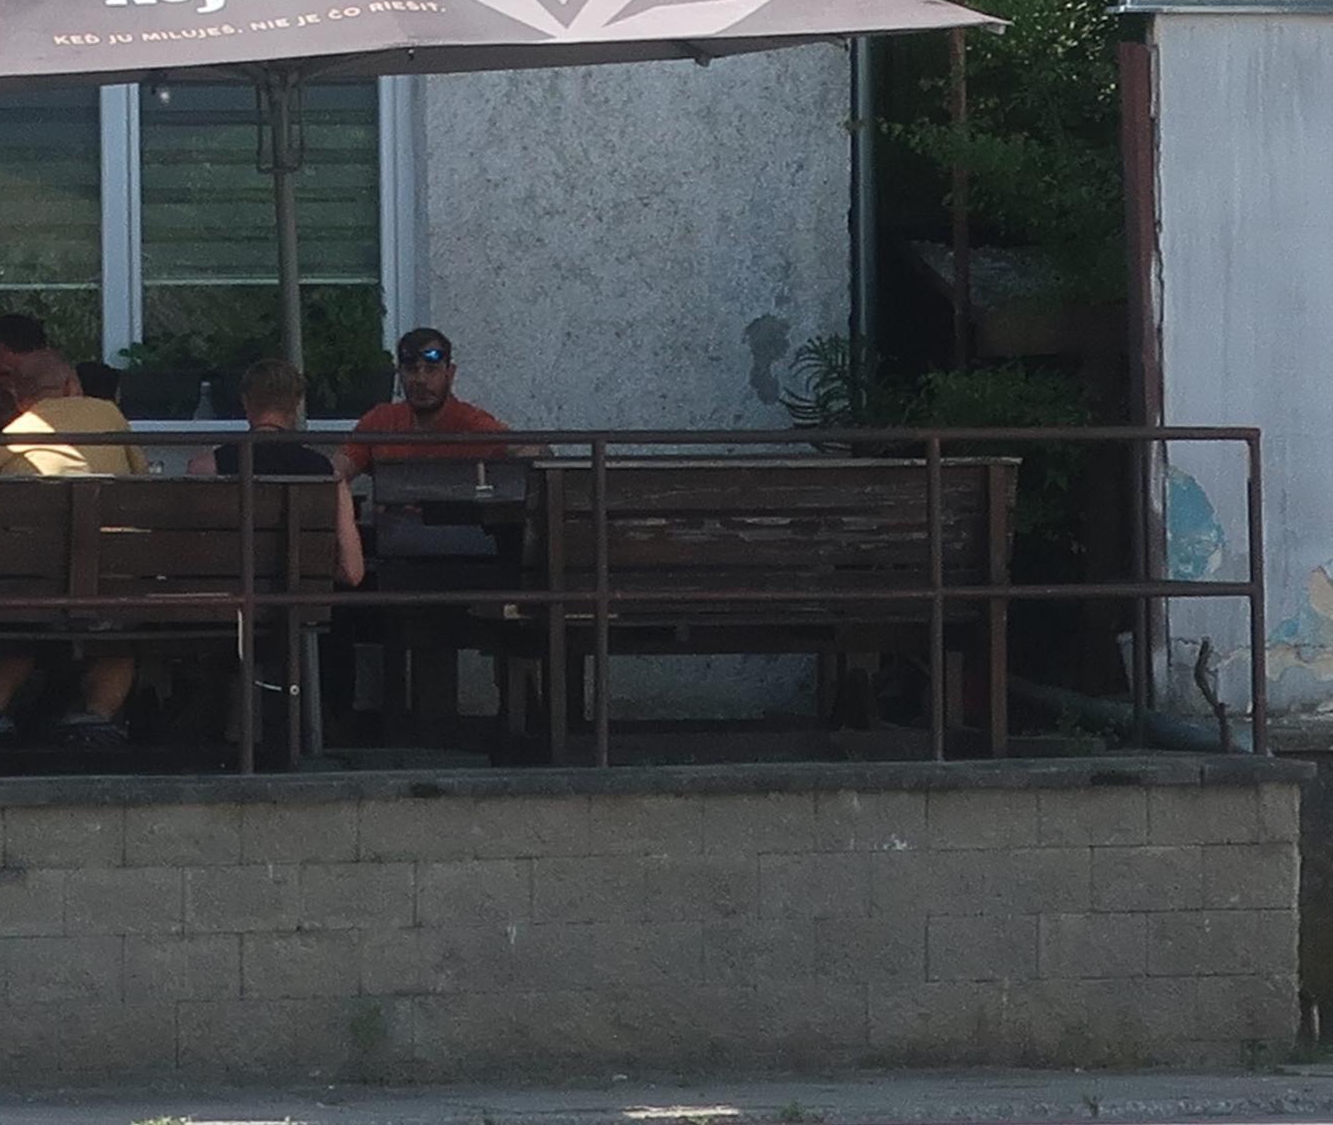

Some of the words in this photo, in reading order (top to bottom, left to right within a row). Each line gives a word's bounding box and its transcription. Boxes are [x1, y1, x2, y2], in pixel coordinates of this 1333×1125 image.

[108, 33, 134, 46] JU
[249, 18, 291, 32] NIE
[296, 12, 322, 27] JE
[327, 5, 362, 20] ČO
